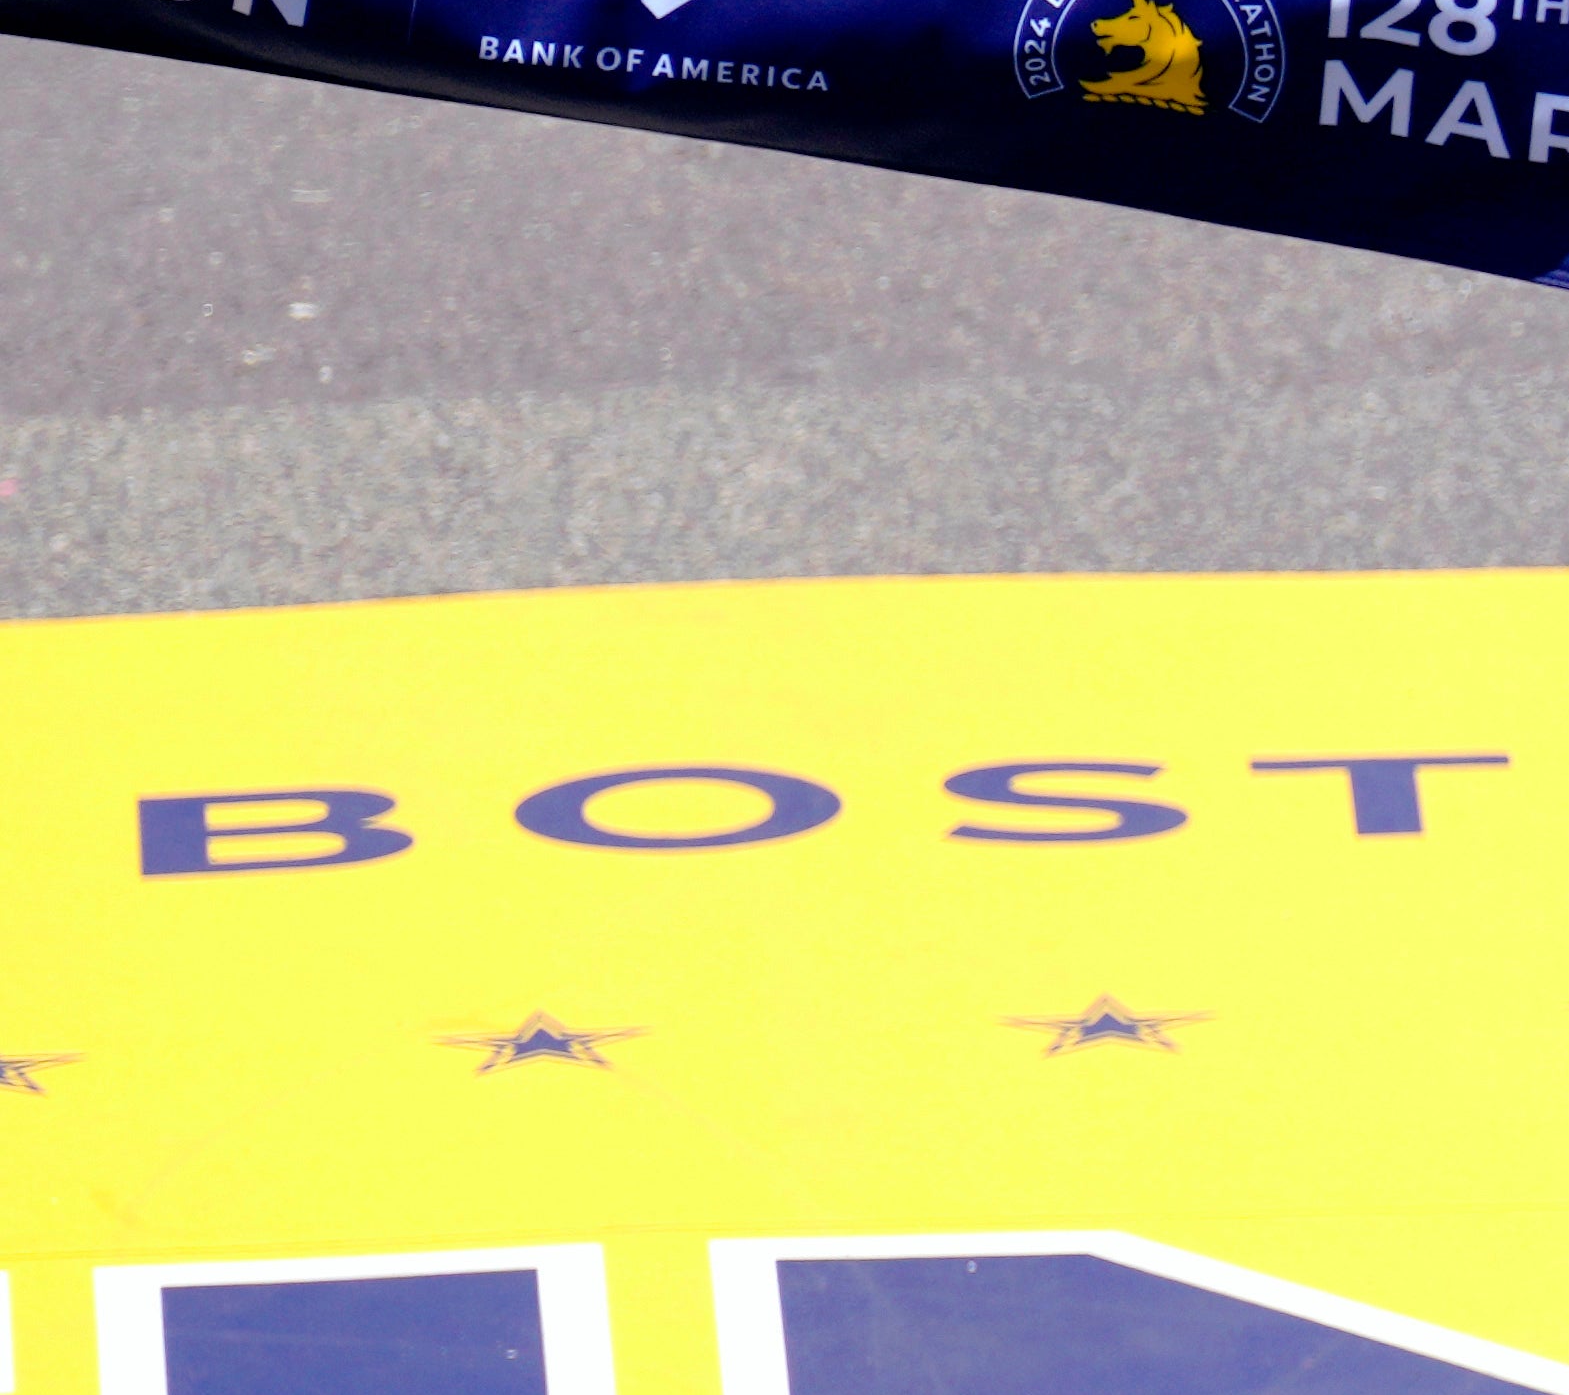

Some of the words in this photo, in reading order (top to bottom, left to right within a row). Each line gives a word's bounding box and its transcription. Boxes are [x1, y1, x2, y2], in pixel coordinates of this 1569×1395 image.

[479, 35, 583, 68] BANK
[596, 47, 645, 73] OF
[651, 53, 829, 91] AMERICA
[1025, 15, 1051, 86] 2024
